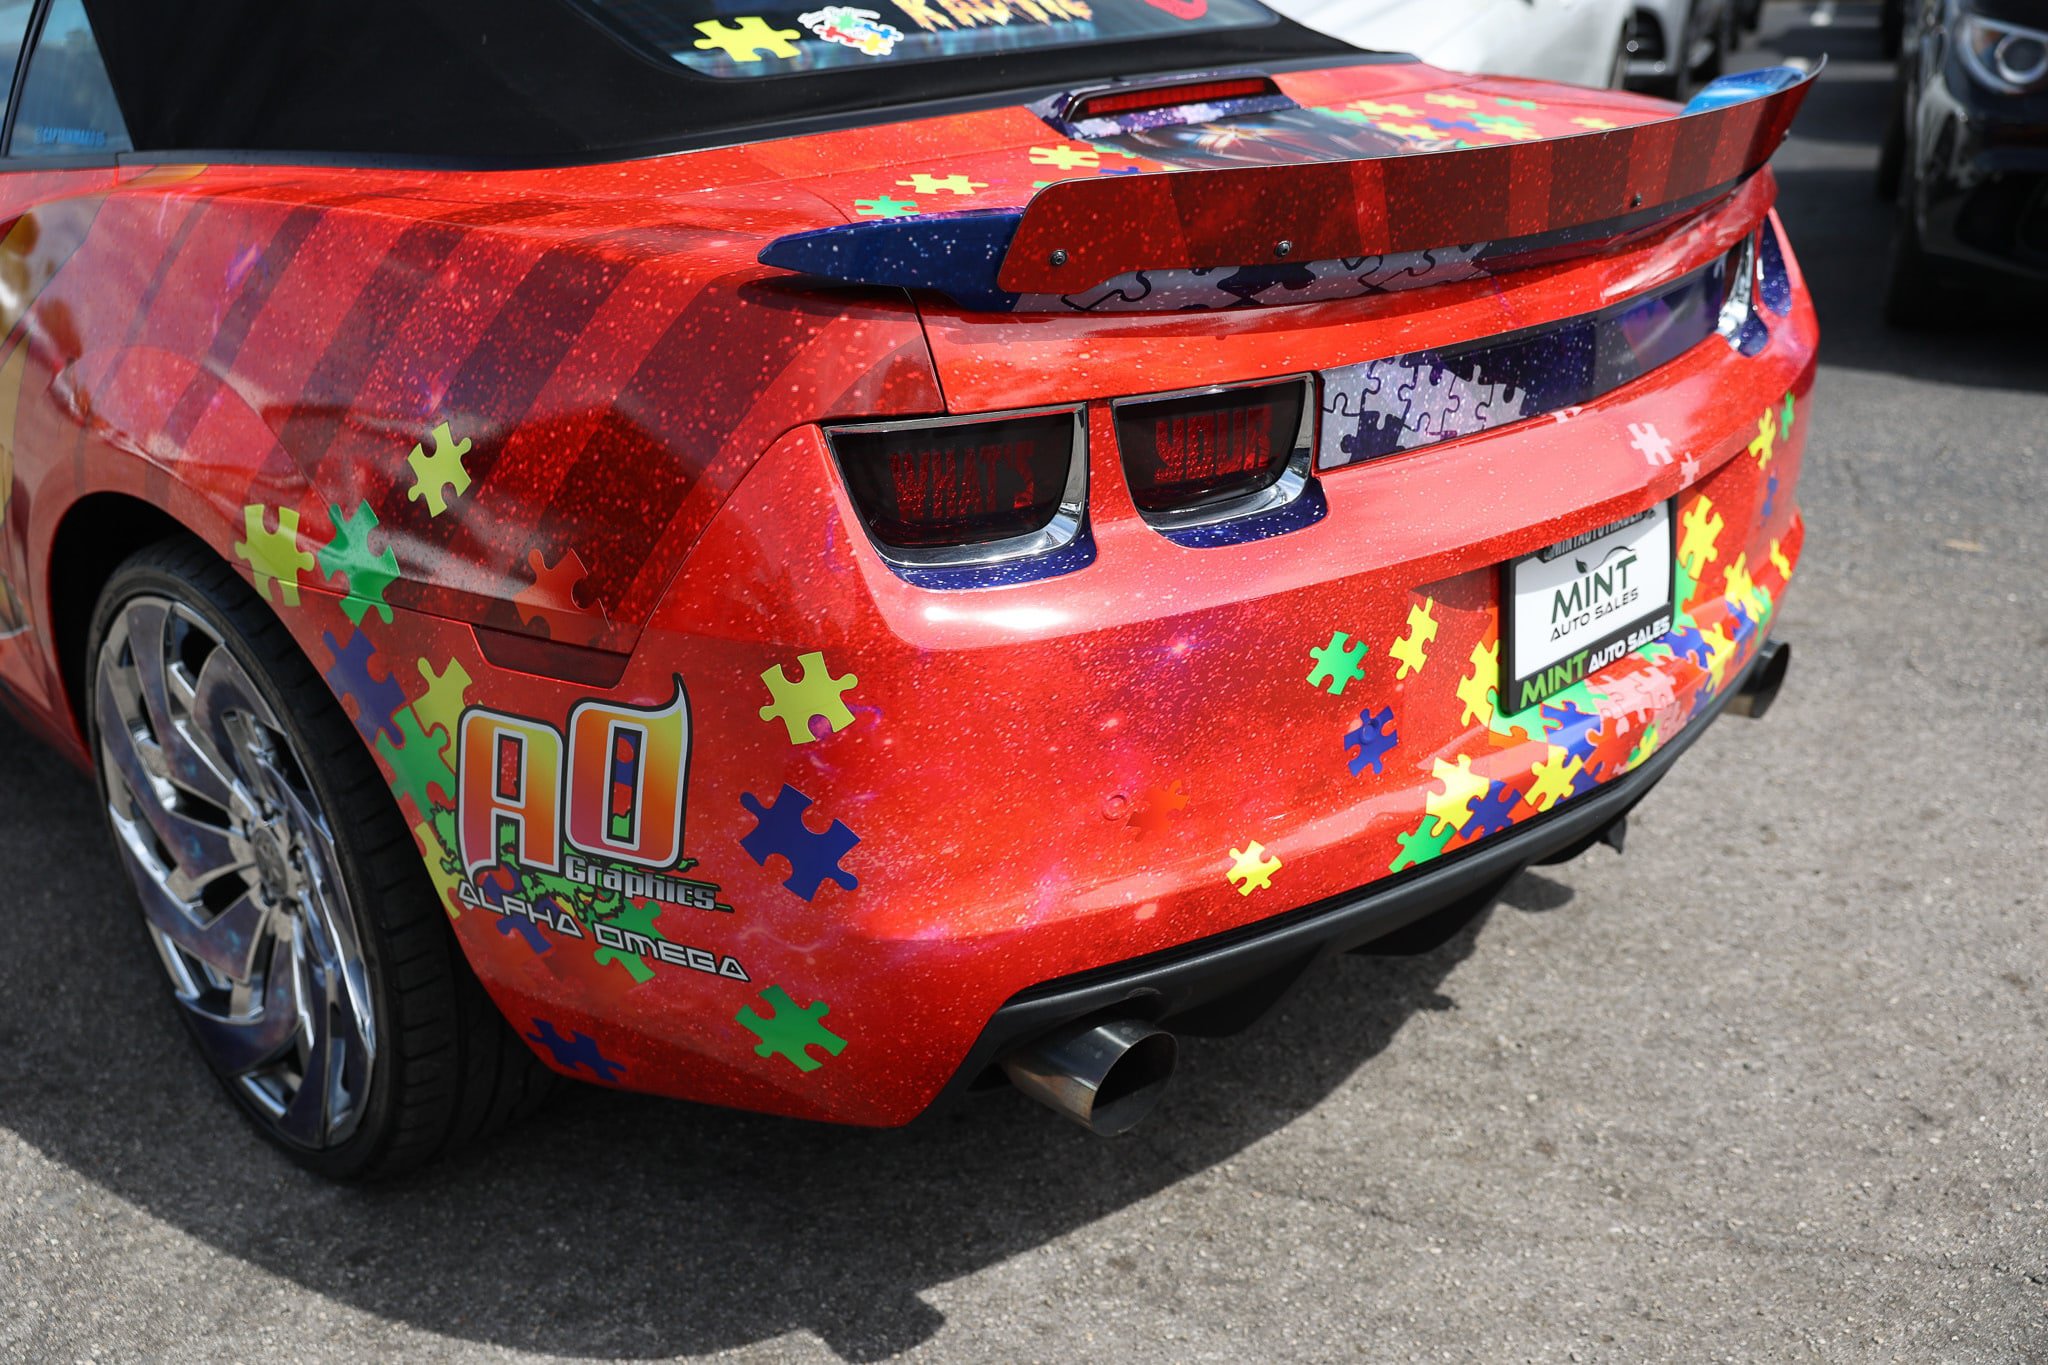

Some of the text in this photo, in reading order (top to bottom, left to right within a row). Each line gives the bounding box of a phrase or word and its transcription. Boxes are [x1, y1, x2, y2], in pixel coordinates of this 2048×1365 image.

[889, 440, 1035, 520] WHAT'S
[1154, 403, 1273, 483] YOUR
[1550, 587, 1638, 643] AUTO SALES
[1551, 554, 1637, 625] MINT
[1519, 615, 1672, 709] MINT AUTO SALES
[455, 671, 693, 888] AO
[563, 852, 720, 913] Graphics
[457, 878, 751, 984] ALPHA OMEGA
